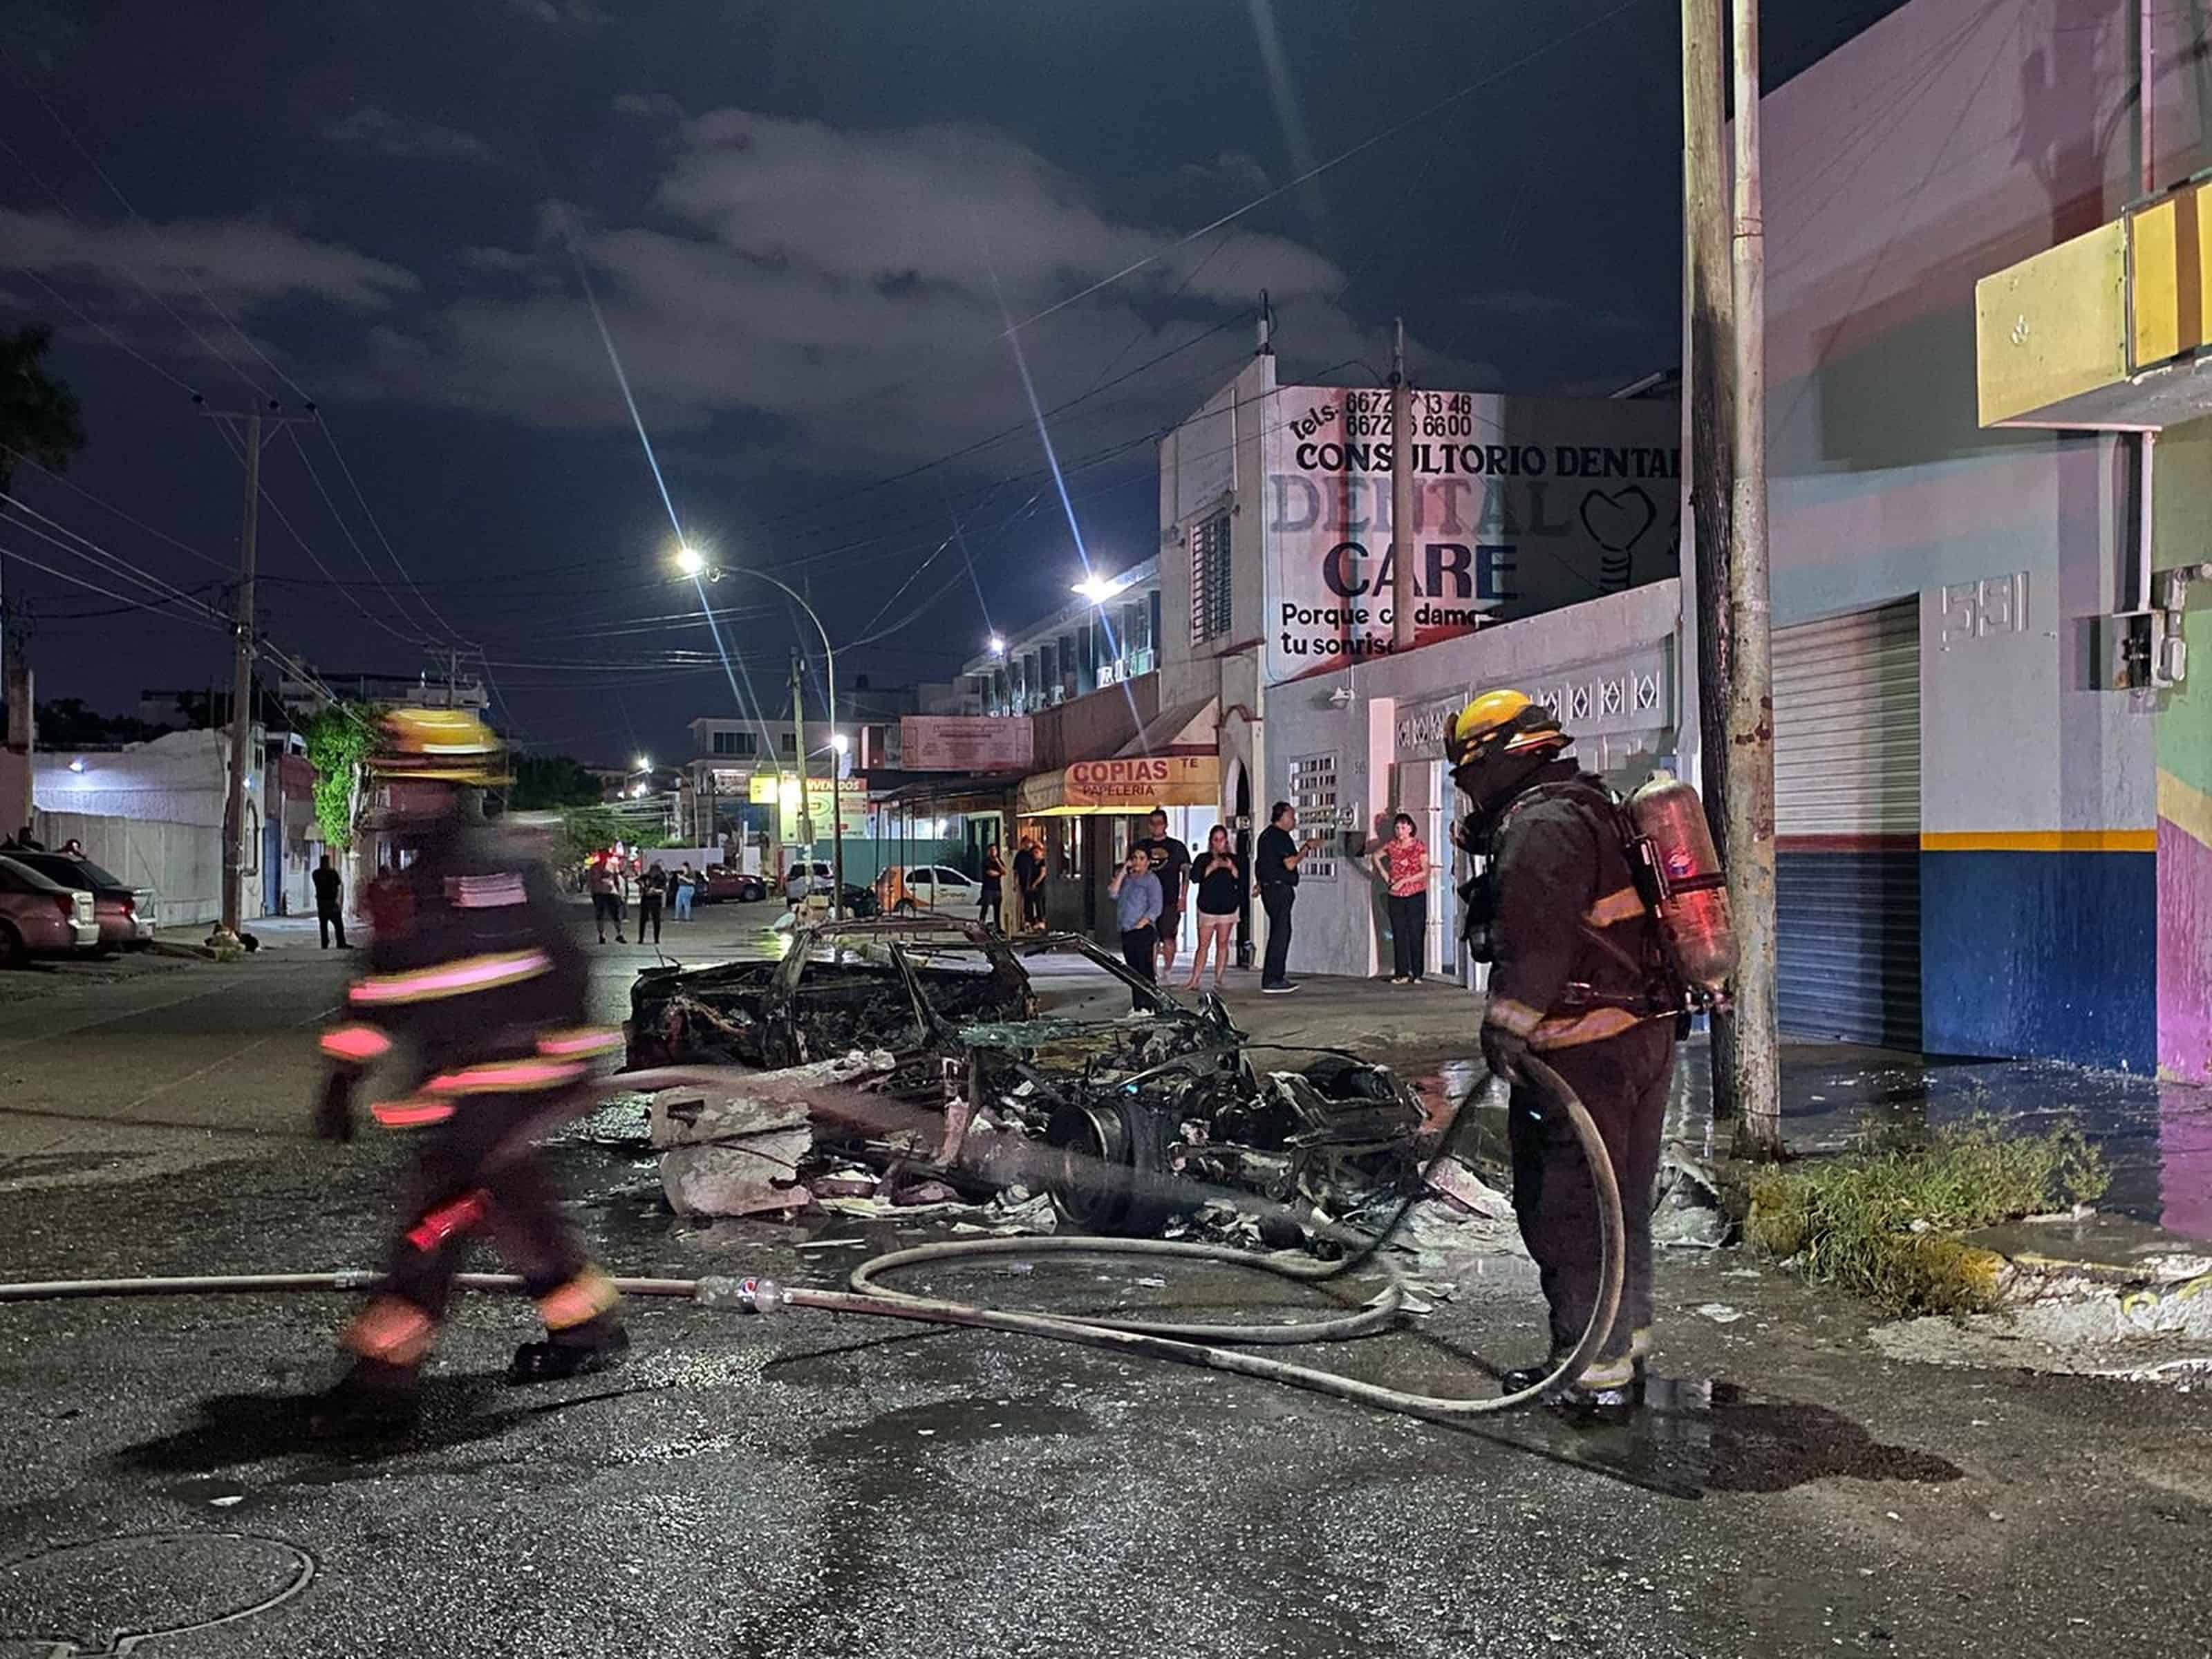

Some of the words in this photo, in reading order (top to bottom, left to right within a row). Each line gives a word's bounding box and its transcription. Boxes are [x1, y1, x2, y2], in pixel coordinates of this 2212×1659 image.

[1347, 391, 1418, 413] 6672
[1423, 393, 1443, 415] 13
[1448, 394, 1472, 415] 46
[1289, 404, 1340, 441] tels.
[1347, 415, 1418, 436] 6672
[1423, 415, 1472, 437] 6600
[1296, 442, 1546, 476] CONSLTORIO
[1323, 542, 1519, 599] CARE
[1282, 602, 1369, 630] Porque
[1281, 632, 1307, 655] tu
[1073, 760, 1168, 782] COPIAS
